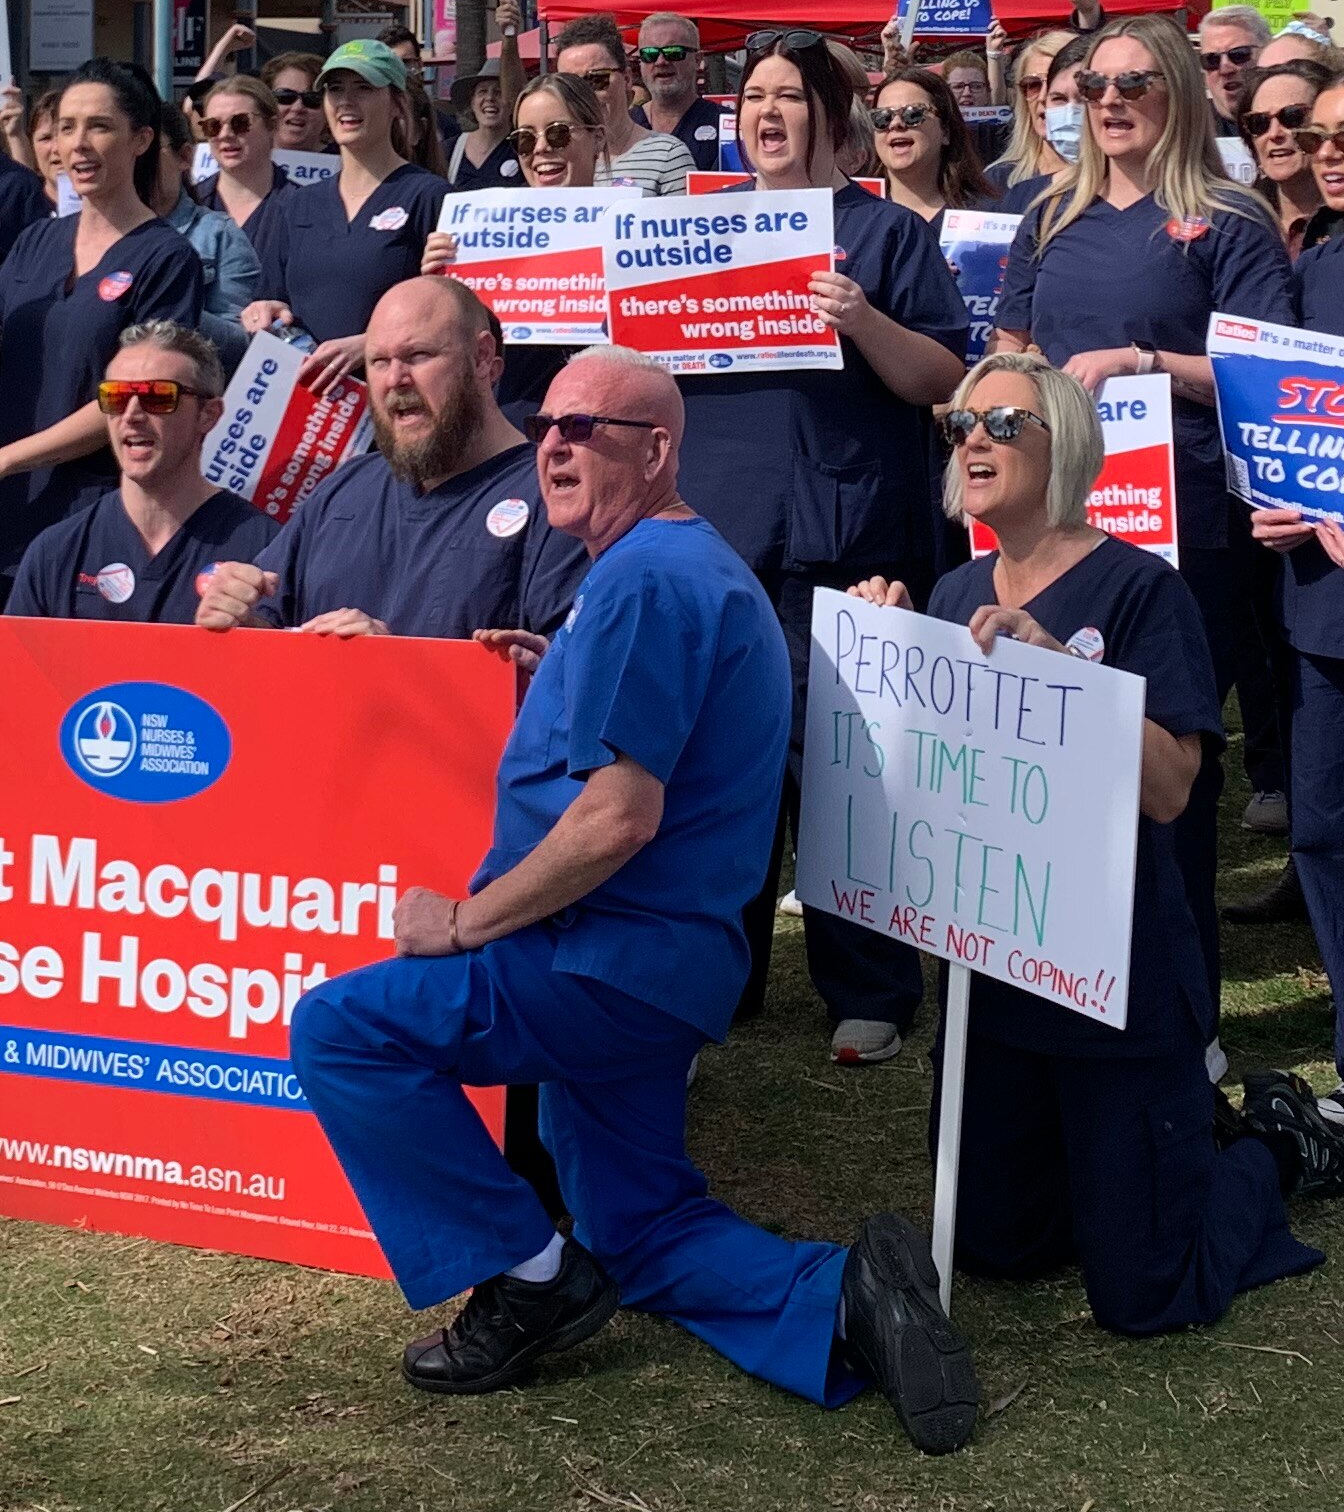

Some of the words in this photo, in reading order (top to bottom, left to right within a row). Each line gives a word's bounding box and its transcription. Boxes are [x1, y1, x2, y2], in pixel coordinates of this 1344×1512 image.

[934, 8, 972, 22] COPE!
[294, 164, 331, 179] are
[451, 202, 471, 225] If
[474, 203, 567, 225] nurses
[615, 213, 636, 240] If
[640, 211, 748, 238] nurses
[754, 210, 809, 232] are
[615, 238, 733, 269] outside
[493, 297, 556, 317] wrong
[619, 292, 699, 318] there's
[702, 288, 819, 315] something
[680, 319, 755, 340] wrong
[758, 314, 827, 336] inside
[1216, 320, 1257, 342] Ratios
[1260, 330, 1279, 344] It's
[1282, 336, 1291, 346] a
[1294, 339, 1334, 356] matter
[246, 358, 279, 405] are
[318, 390, 361, 453] inside
[1099, 399, 1147, 423] are
[1252, 455, 1285, 483] TO
[1096, 511, 1163, 534] inside
[836, 610, 1084, 747] PERROTTET
[142, 713, 168, 728] NSW
[141, 728, 185, 744] NURSES
[186, 731, 195, 744] &
[140, 757, 209, 776] ASSOCIATION
[831, 710, 886, 779] IT'S
[904, 729, 989, 807] TIME
[1001, 756, 1049, 826] TO
[846, 794, 1051, 947] LISTEN
[30, 834, 398, 940] Macquari
[831, 879, 876, 924] WE
[888, 904, 937, 948] ARE
[946, 924, 995, 967] NOT
[1008, 948, 1117, 1014] COPING!!
[4, 1040, 21, 1064] &
[25, 1042, 151, 1081] MIDWIVES'
[156, 1059, 308, 1101] ASSOCIATIO
